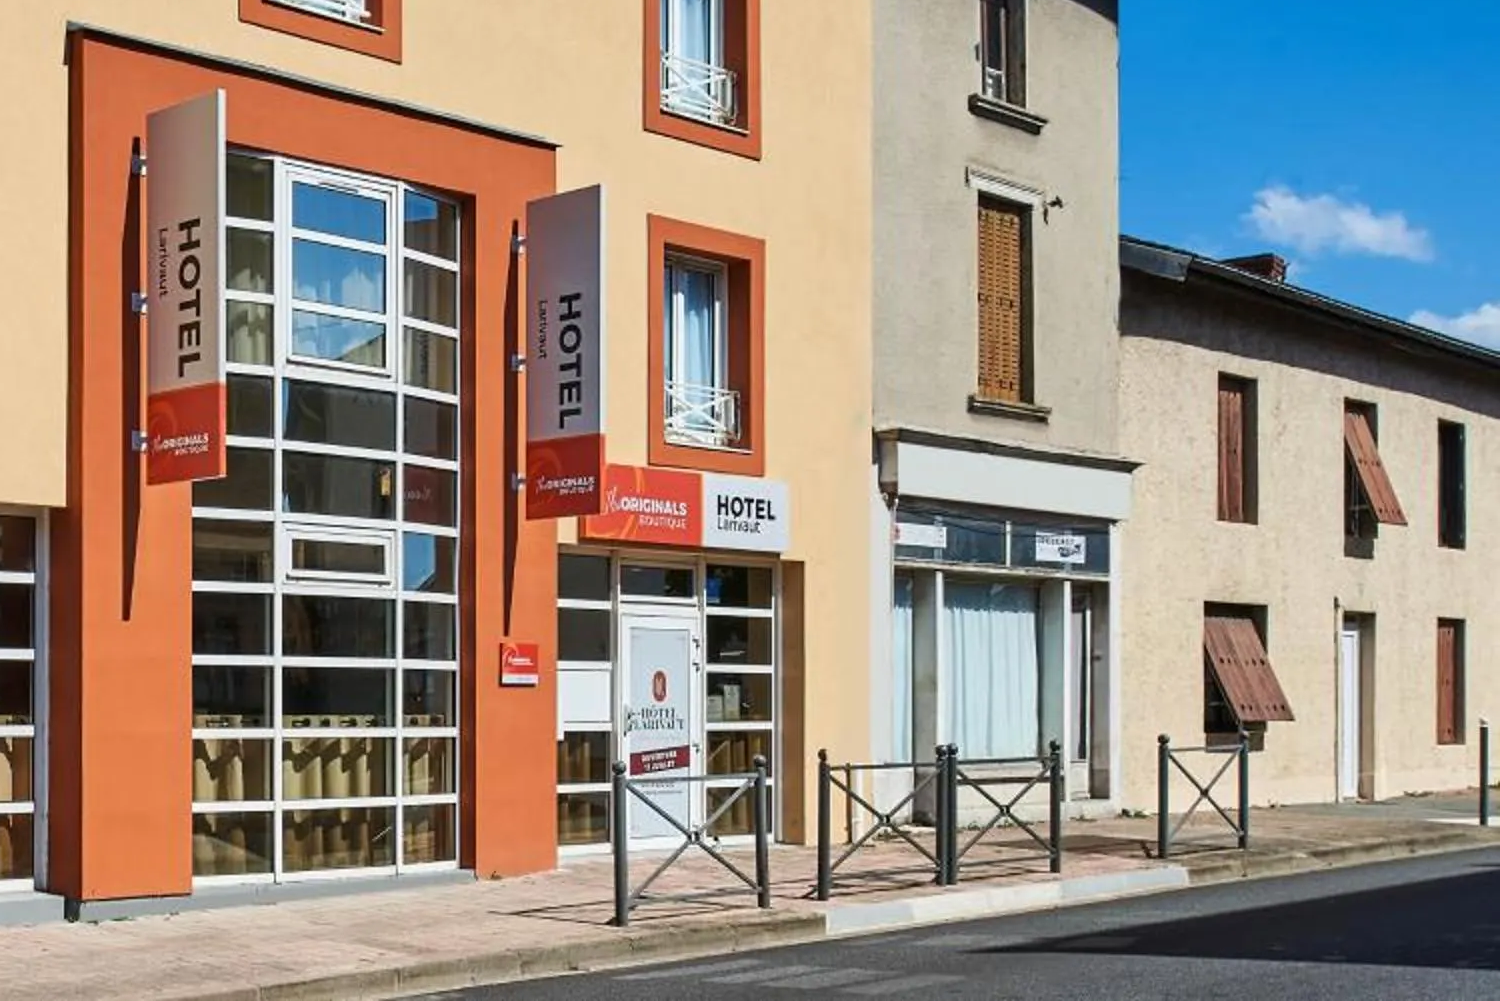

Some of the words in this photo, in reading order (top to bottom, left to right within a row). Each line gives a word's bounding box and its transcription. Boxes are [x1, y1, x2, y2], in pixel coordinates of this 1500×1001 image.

[178, 217, 201, 378] HOTEL
[559, 292, 582, 429] HOTEL
[620, 495, 688, 517] ORIGINALS
[716, 494, 776, 521] HOTEL
[638, 514, 687, 530] BOUTIQUE
